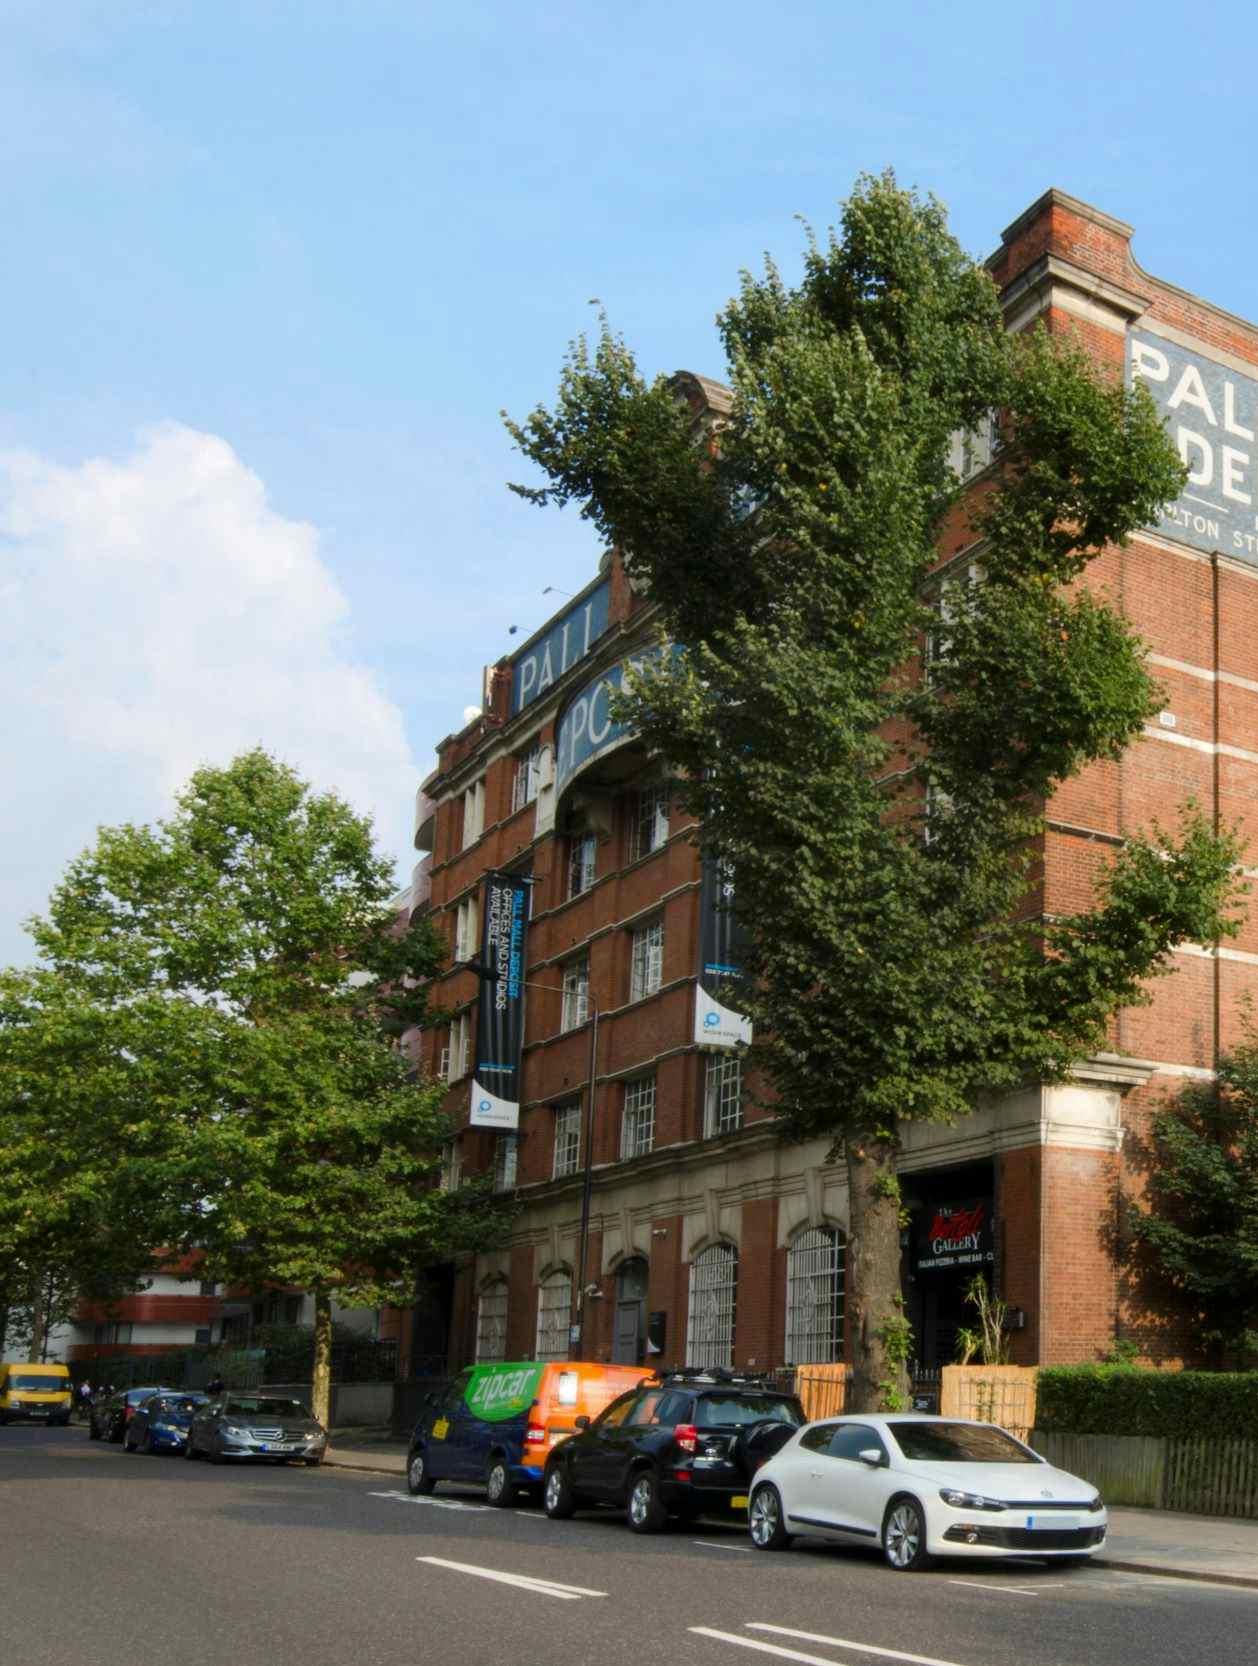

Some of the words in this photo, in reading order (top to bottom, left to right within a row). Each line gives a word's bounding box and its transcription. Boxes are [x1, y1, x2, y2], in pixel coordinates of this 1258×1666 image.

[488, 886, 501, 945] AVAILABLE
[501, 888, 513, 933] OFFICES
[512, 888, 524, 917] PALL
[498, 934, 509, 960] AND
[510, 919, 522, 949] MALL
[495, 962, 508, 1010] STUDIOS
[932, 1231, 981, 1254] GALLERY
[472, 1367, 536, 1410] zipcar
